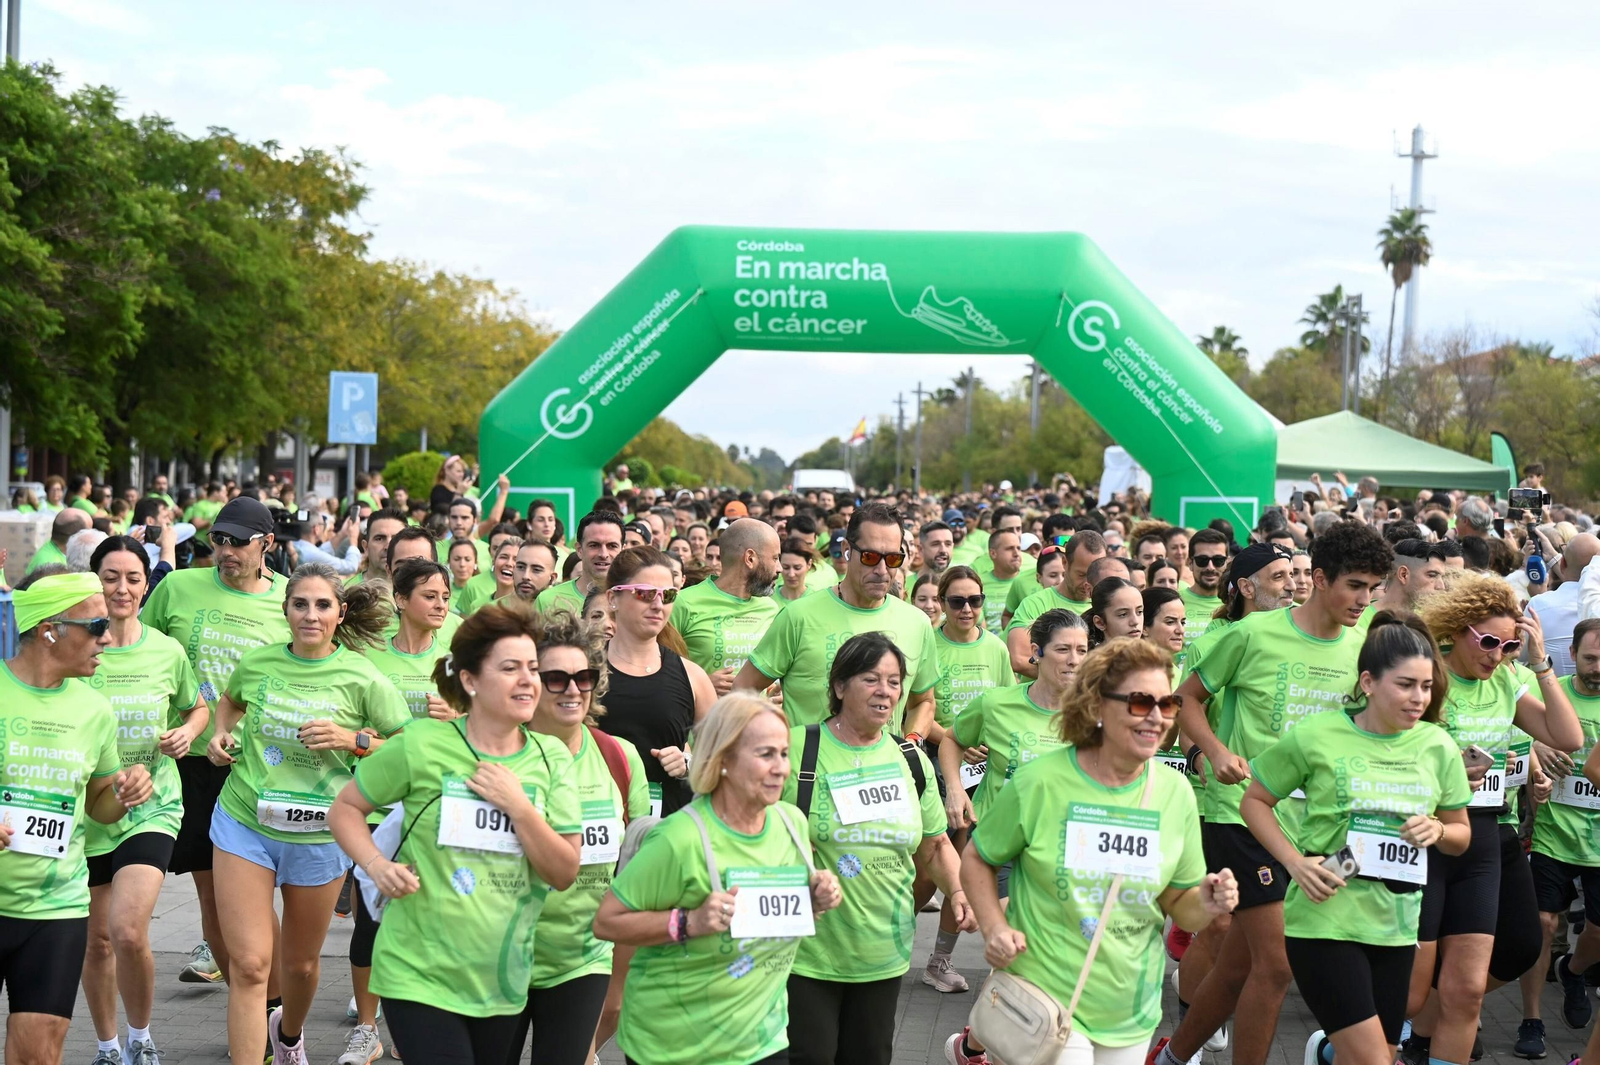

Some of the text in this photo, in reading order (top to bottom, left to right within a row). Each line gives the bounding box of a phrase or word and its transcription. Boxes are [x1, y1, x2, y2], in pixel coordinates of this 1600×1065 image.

[736, 239, 804, 252] Córdoba
[735, 255, 887, 281] En marcha
[733, 284, 828, 309] contra
[734, 311, 868, 334] el cáncer
[578, 288, 681, 385] asociación española
[1101, 357, 1119, 375] en
[599, 349, 662, 407] en Córdoba
[1112, 347, 1194, 426] contra el cáncer
[1123, 336, 1224, 435] asociación española
[342, 382, 365, 412] P
[203, 627, 220, 640] En
[724, 631, 737, 640] En
[200, 644, 242, 660] contr
[725, 644, 752, 654] cont
[198, 658, 236, 675] cán
[952, 679, 964, 687] En
[1289, 683, 1306, 697] En
[266, 693, 338, 712] En marcha
[1269, 661, 1289, 733] CÓRDOBA
[147, 708, 159, 720] el
[1286, 703, 1337, 716] cont
[31, 719, 57, 728] asociación
[1458, 714, 1474, 726] En
[261, 721, 301, 741] cán
[9, 741, 86, 764] En marcha
[6, 762, 84, 784] contra el
[965, 763, 987, 777] 258
[858, 784, 902, 806] 0962
[1350, 777, 1432, 797] En marcha
[1574, 781, 1600, 799] 014
[285, 808, 325, 822] 1256
[1072, 805, 1108, 817] Córdoba
[1351, 798, 1411, 815] contra
[24, 815, 65, 841] 2501
[475, 808, 516, 834] 091
[1354, 817, 1385, 827] Córdoba
[833, 824, 917, 845] cáncer
[1098, 831, 1148, 858] 3448
[1378, 842, 1419, 867] 1092
[759, 895, 802, 917] 0972
